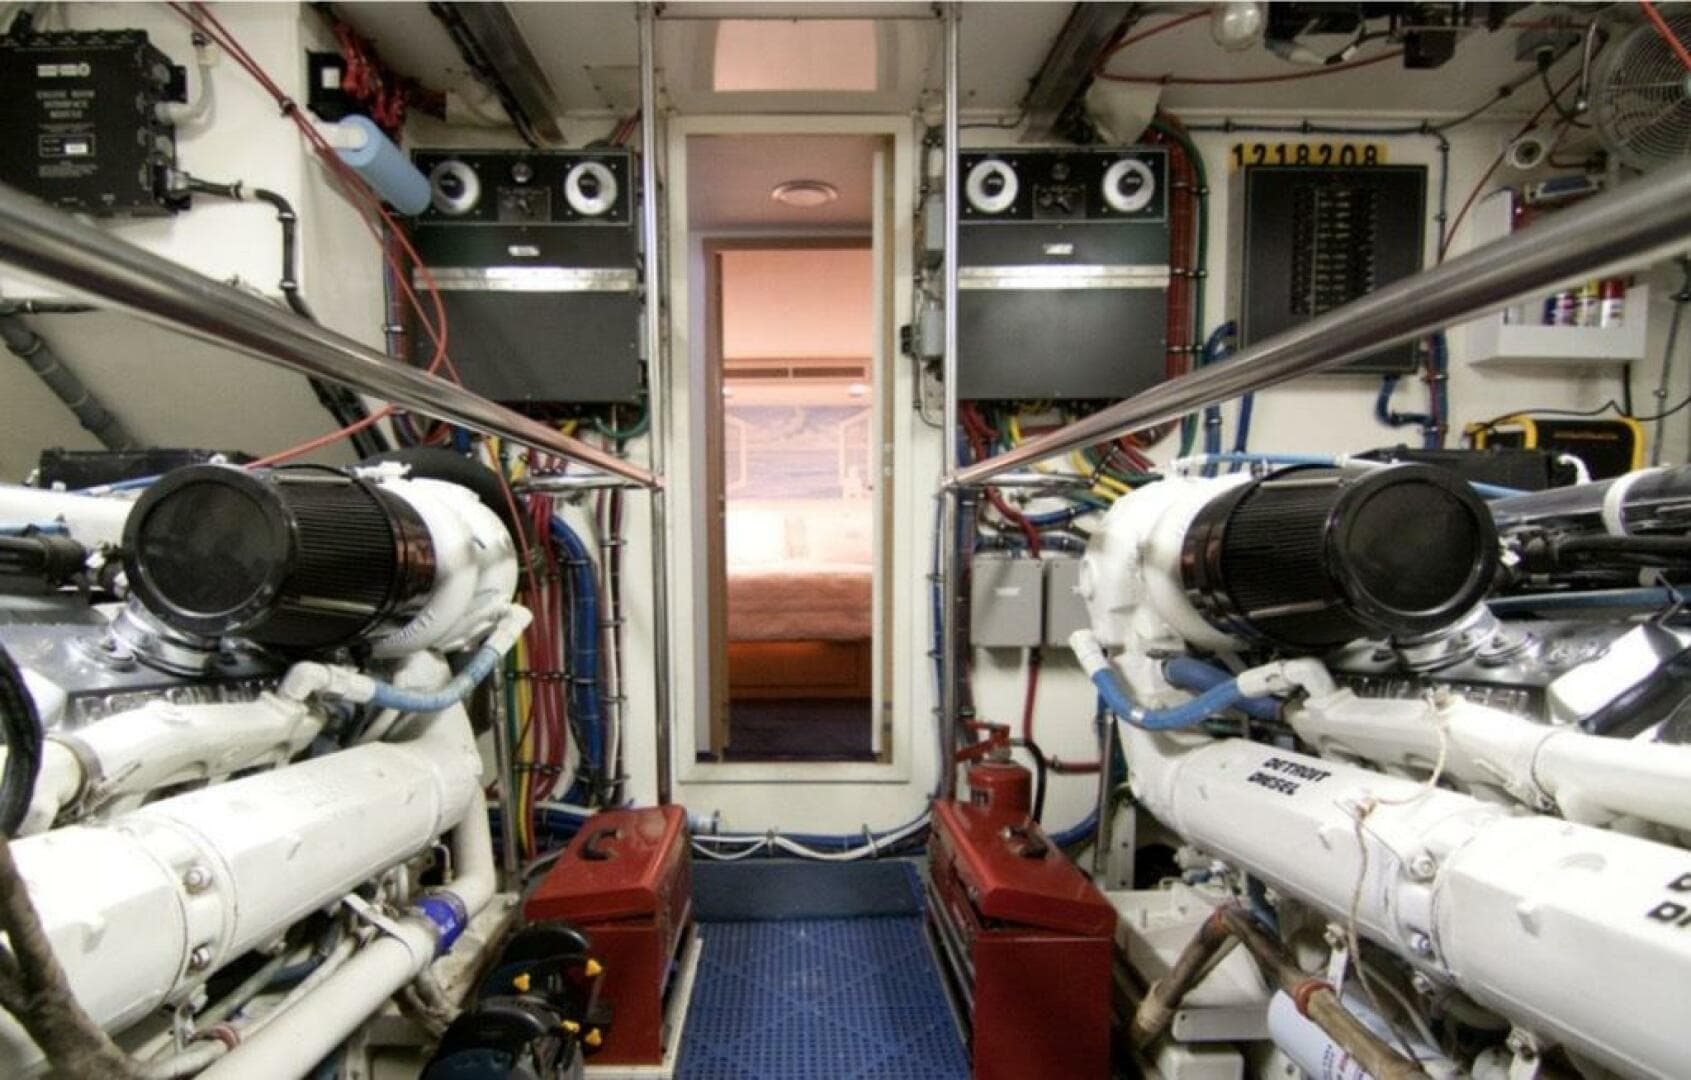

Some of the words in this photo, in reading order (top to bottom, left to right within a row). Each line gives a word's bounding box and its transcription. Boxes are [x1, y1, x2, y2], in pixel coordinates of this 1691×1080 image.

[1232, 143, 1377, 166] 1218208
[1263, 757, 1331, 782] DETROIT
[1246, 771, 1300, 795] DIESEL
